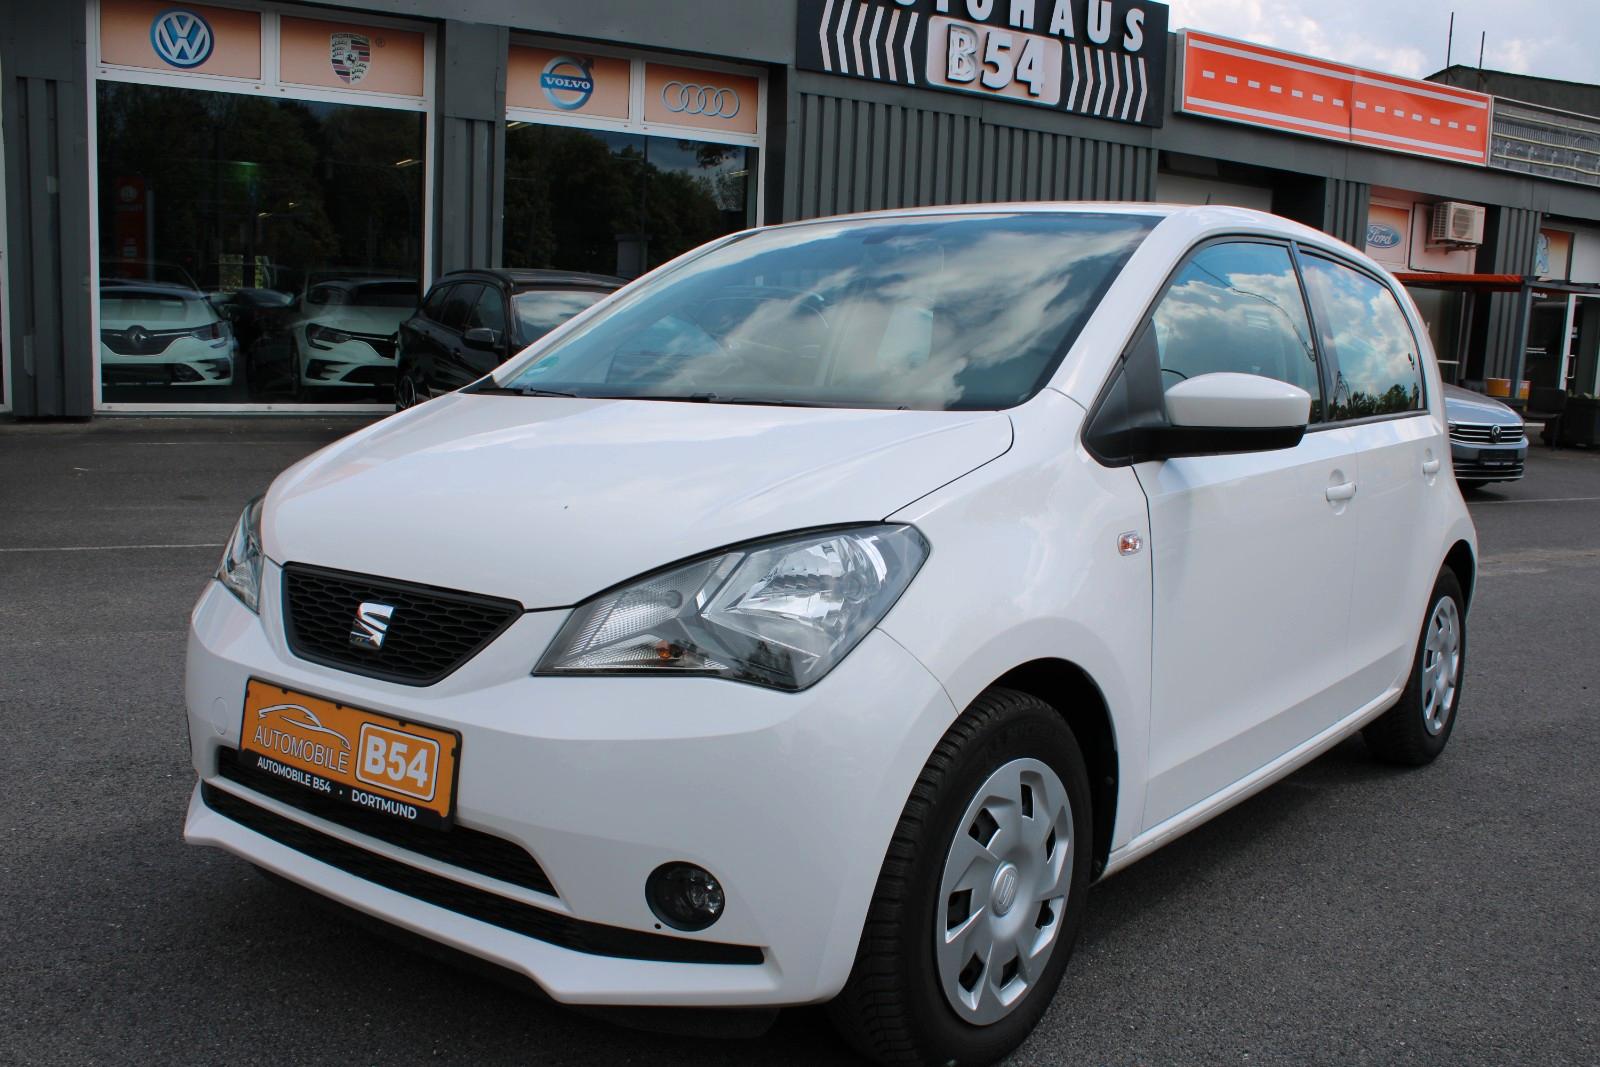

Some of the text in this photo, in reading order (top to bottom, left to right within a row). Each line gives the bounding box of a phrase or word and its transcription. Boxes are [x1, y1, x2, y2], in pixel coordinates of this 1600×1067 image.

[894, 0, 1145, 52] HAUS
[544, 77, 591, 90] VOLVO
[948, 24, 1046, 96] B54
[1367, 225, 1393, 246] Ford
[254, 725, 350, 774] AUTOMOBILE
[364, 734, 429, 788] B54
[257, 756, 418, 820] AUTOMOBILE B54 DORTMUND
